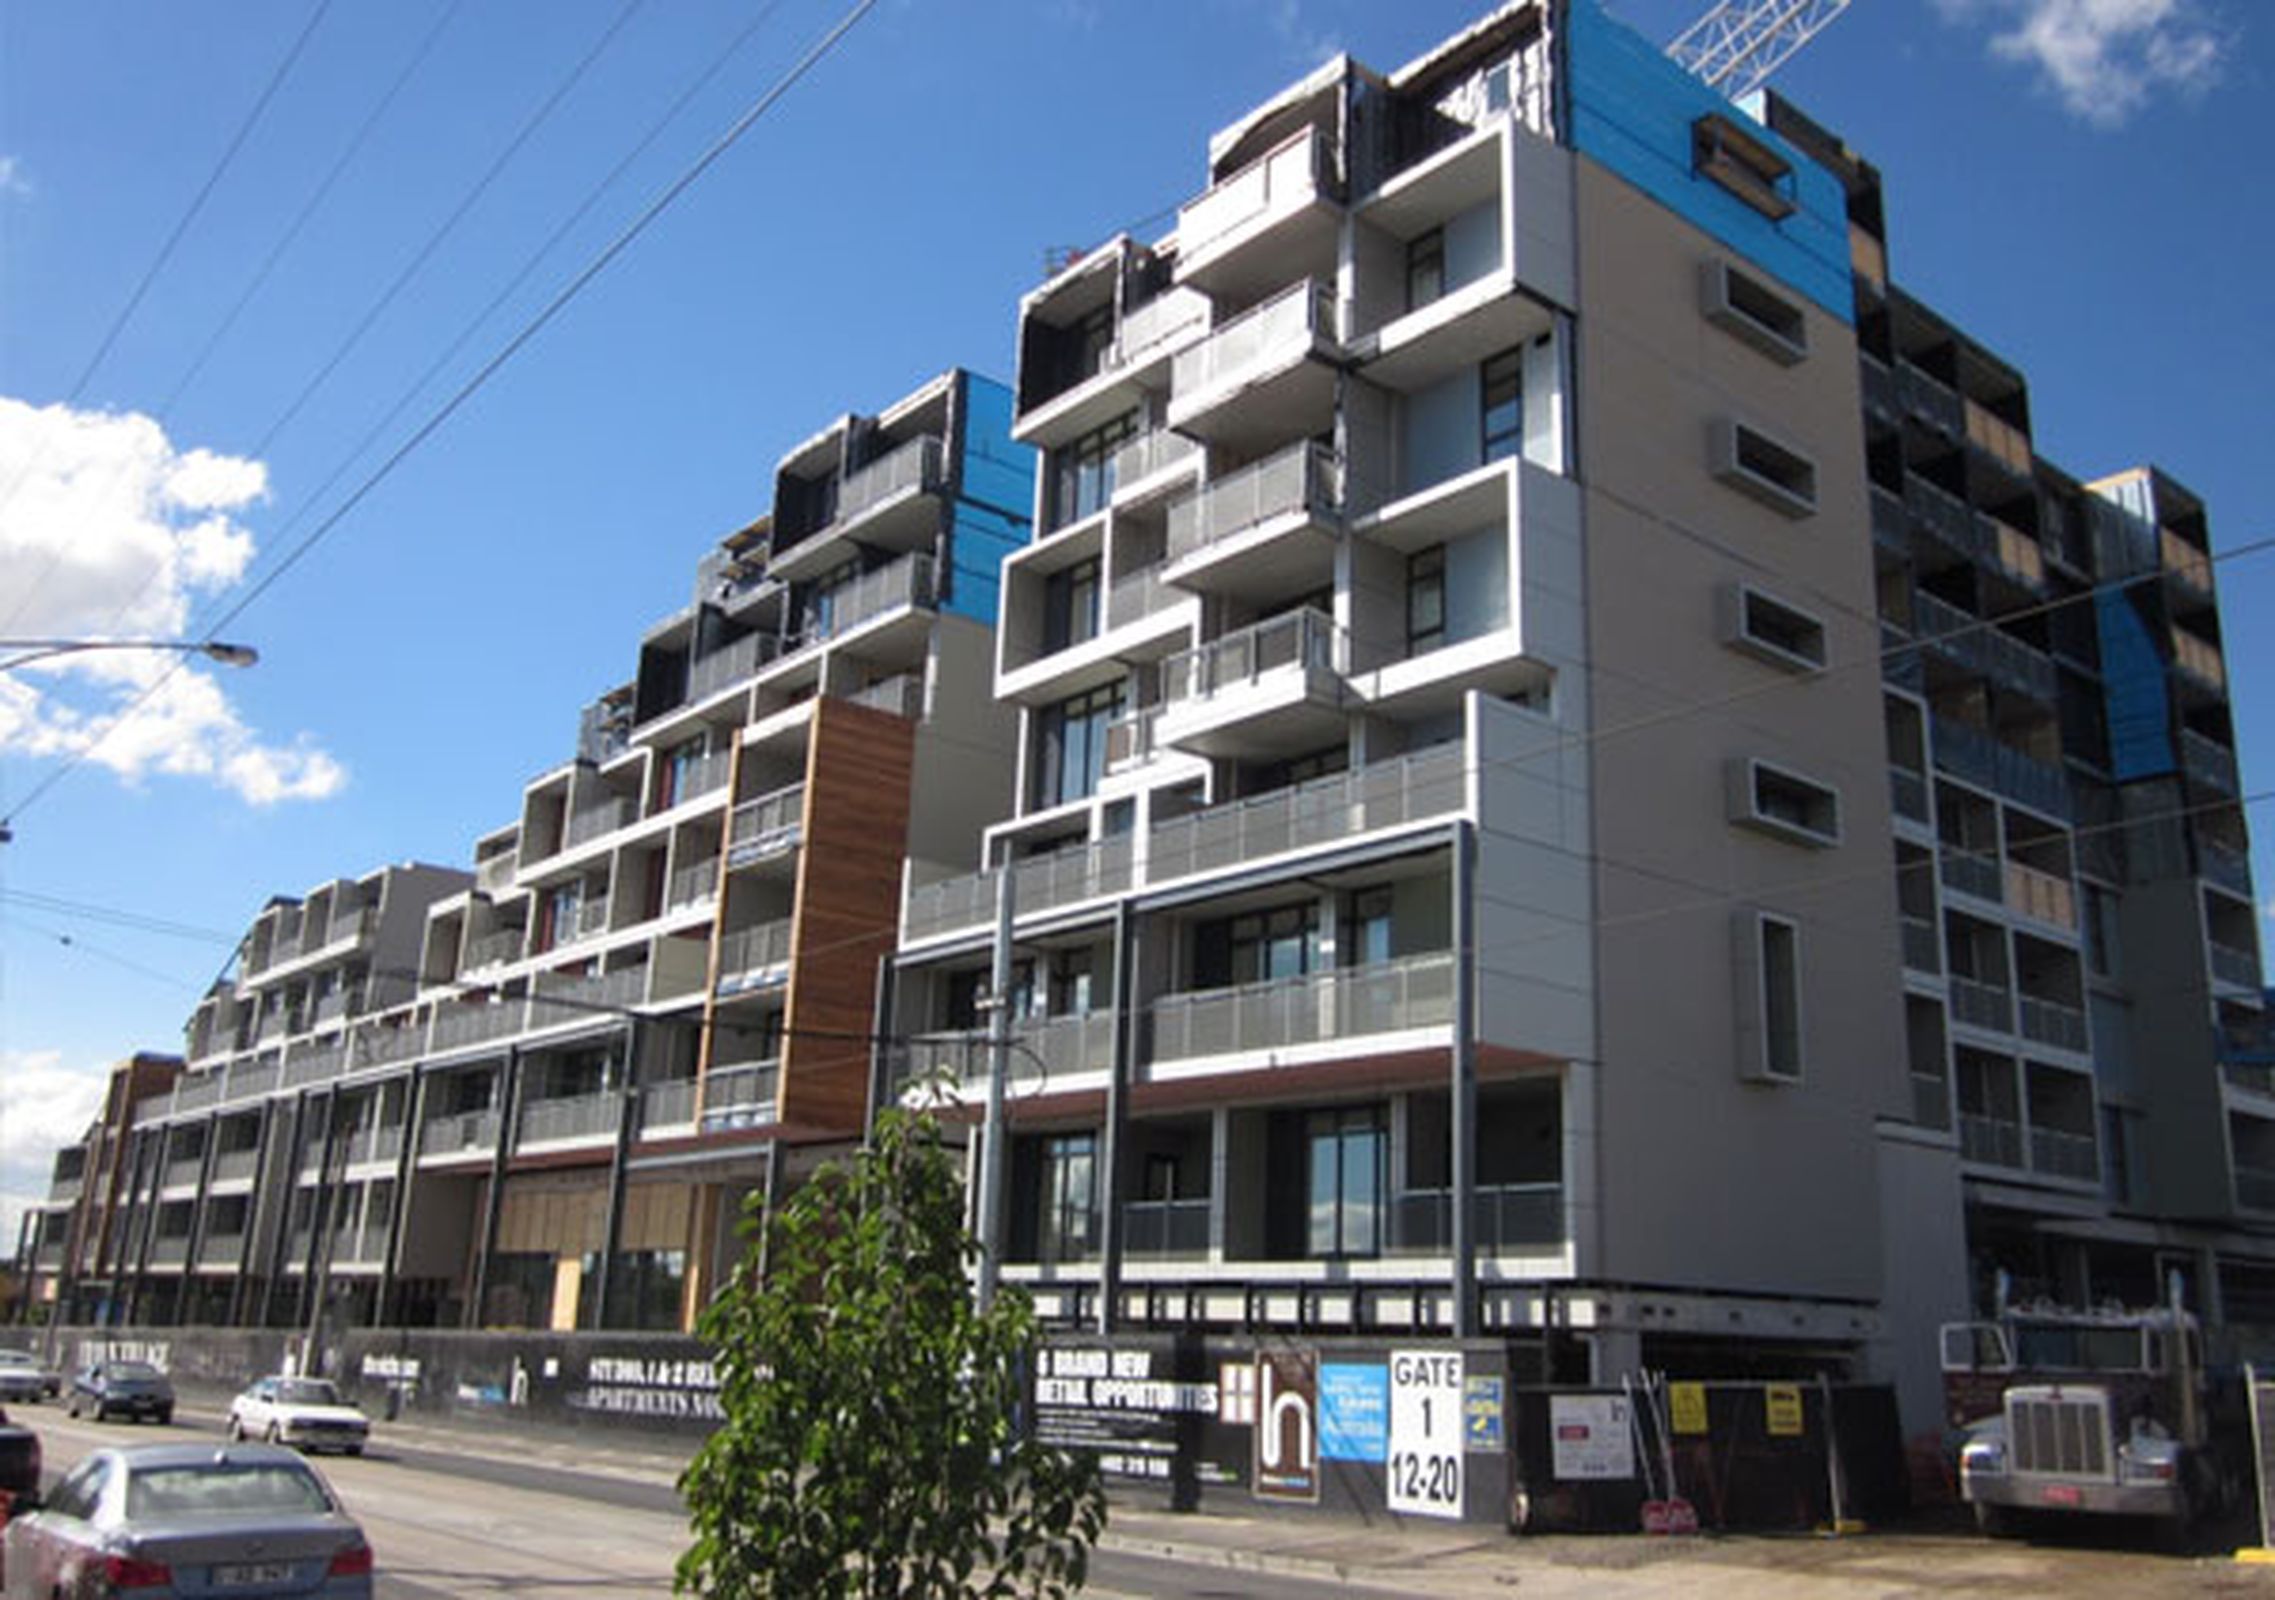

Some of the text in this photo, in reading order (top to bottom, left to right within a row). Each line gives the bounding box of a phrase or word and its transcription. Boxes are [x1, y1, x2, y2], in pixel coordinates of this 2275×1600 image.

[1112, 1351, 1151, 1378] NEW
[1395, 1356, 1460, 1387] GATE
[1262, 1362, 1310, 1468] h
[1422, 1397, 1431, 1438] 1
